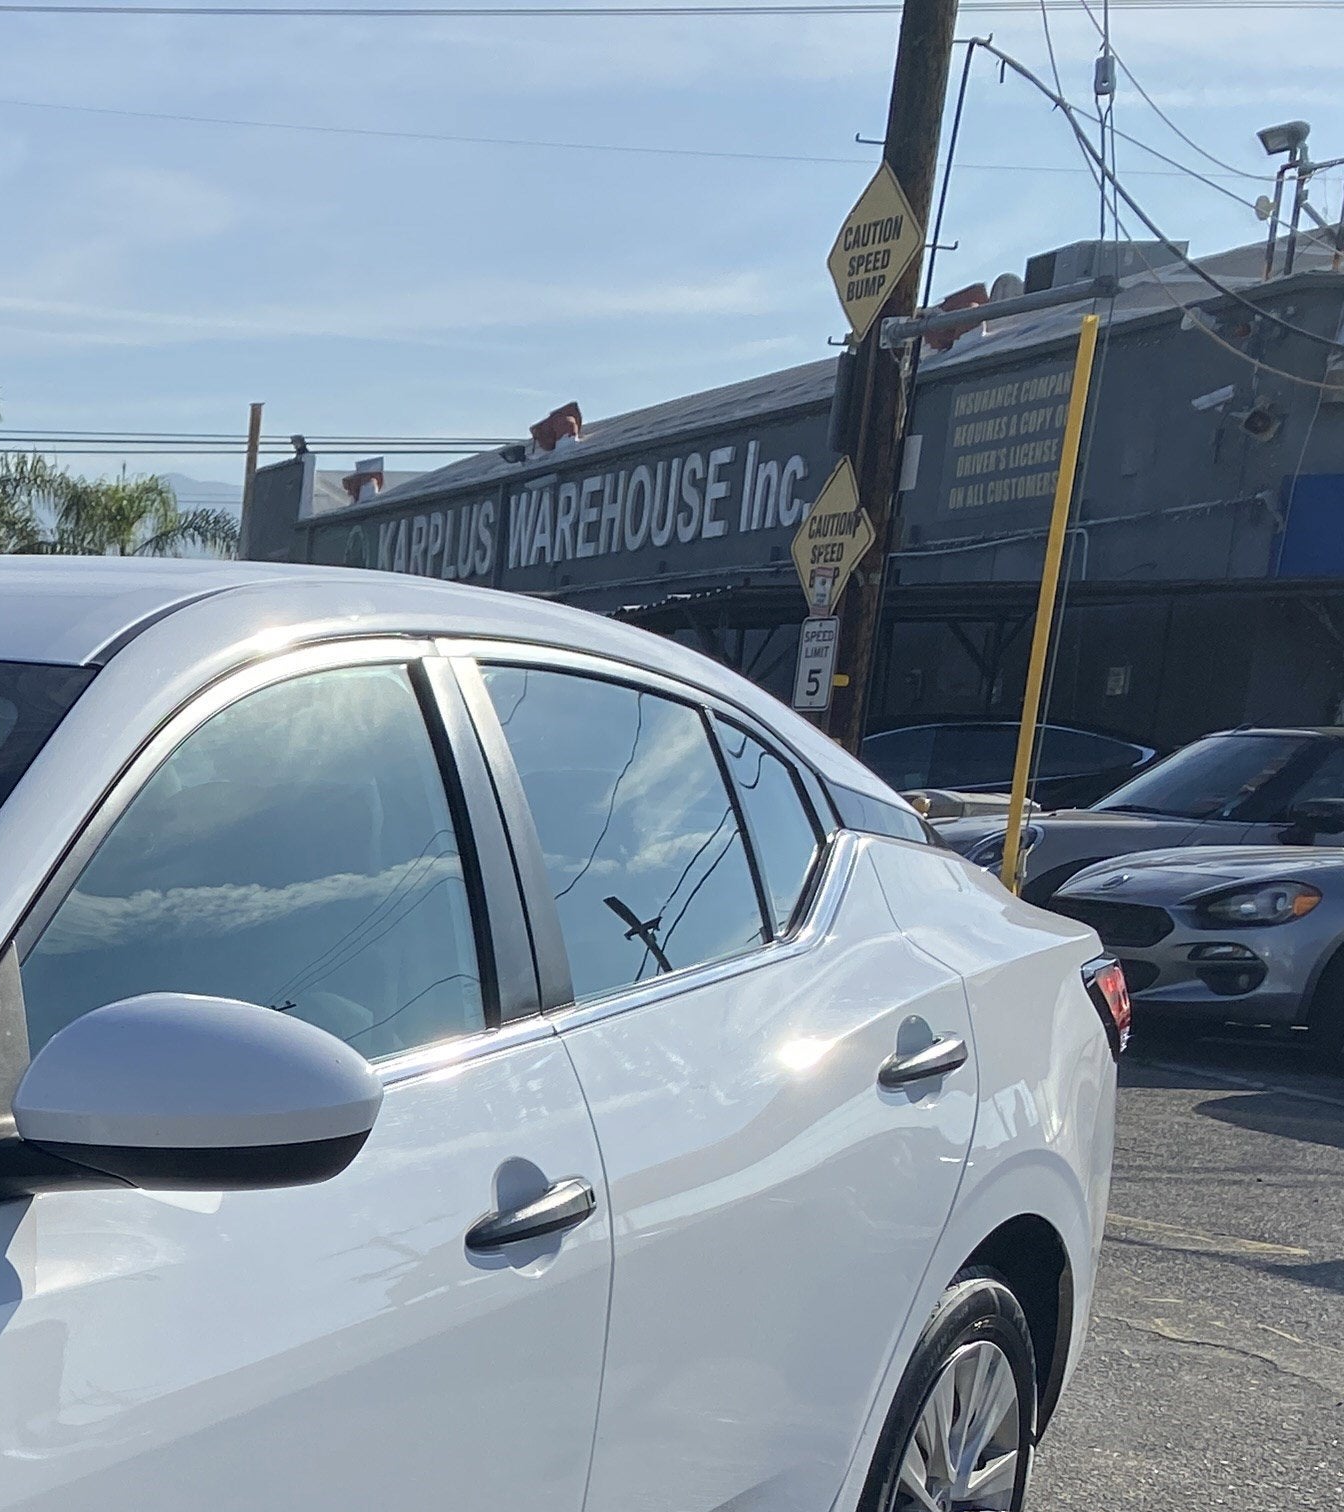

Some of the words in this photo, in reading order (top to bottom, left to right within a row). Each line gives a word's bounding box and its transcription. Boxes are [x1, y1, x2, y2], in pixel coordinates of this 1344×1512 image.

[843, 215, 903, 251] CAUTION
[847, 249, 891, 277] SPEED
[846, 274, 886, 302] BUMP
[954, 382, 1019, 417] INSURANCE
[1020, 370, 1073, 403] COMPAN
[953, 416, 1008, 448] REQUIRES
[1008, 414, 1018, 437] A
[1020, 406, 1054, 435] COPY
[1009, 438, 1059, 469] LICENSE
[965, 483, 985, 507] ALL
[377, 500, 495, 579] KARPLUS
[508, 446, 736, 569] WAREHOUSE
[808, 512, 854, 540] CAUTION
[810, 541, 843, 565] SPEED
[808, 567, 840, 589] BP
[803, 630, 834, 643] SPEED
[804, 646, 830, 659] LIMIT
[805, 669, 822, 697] 5
